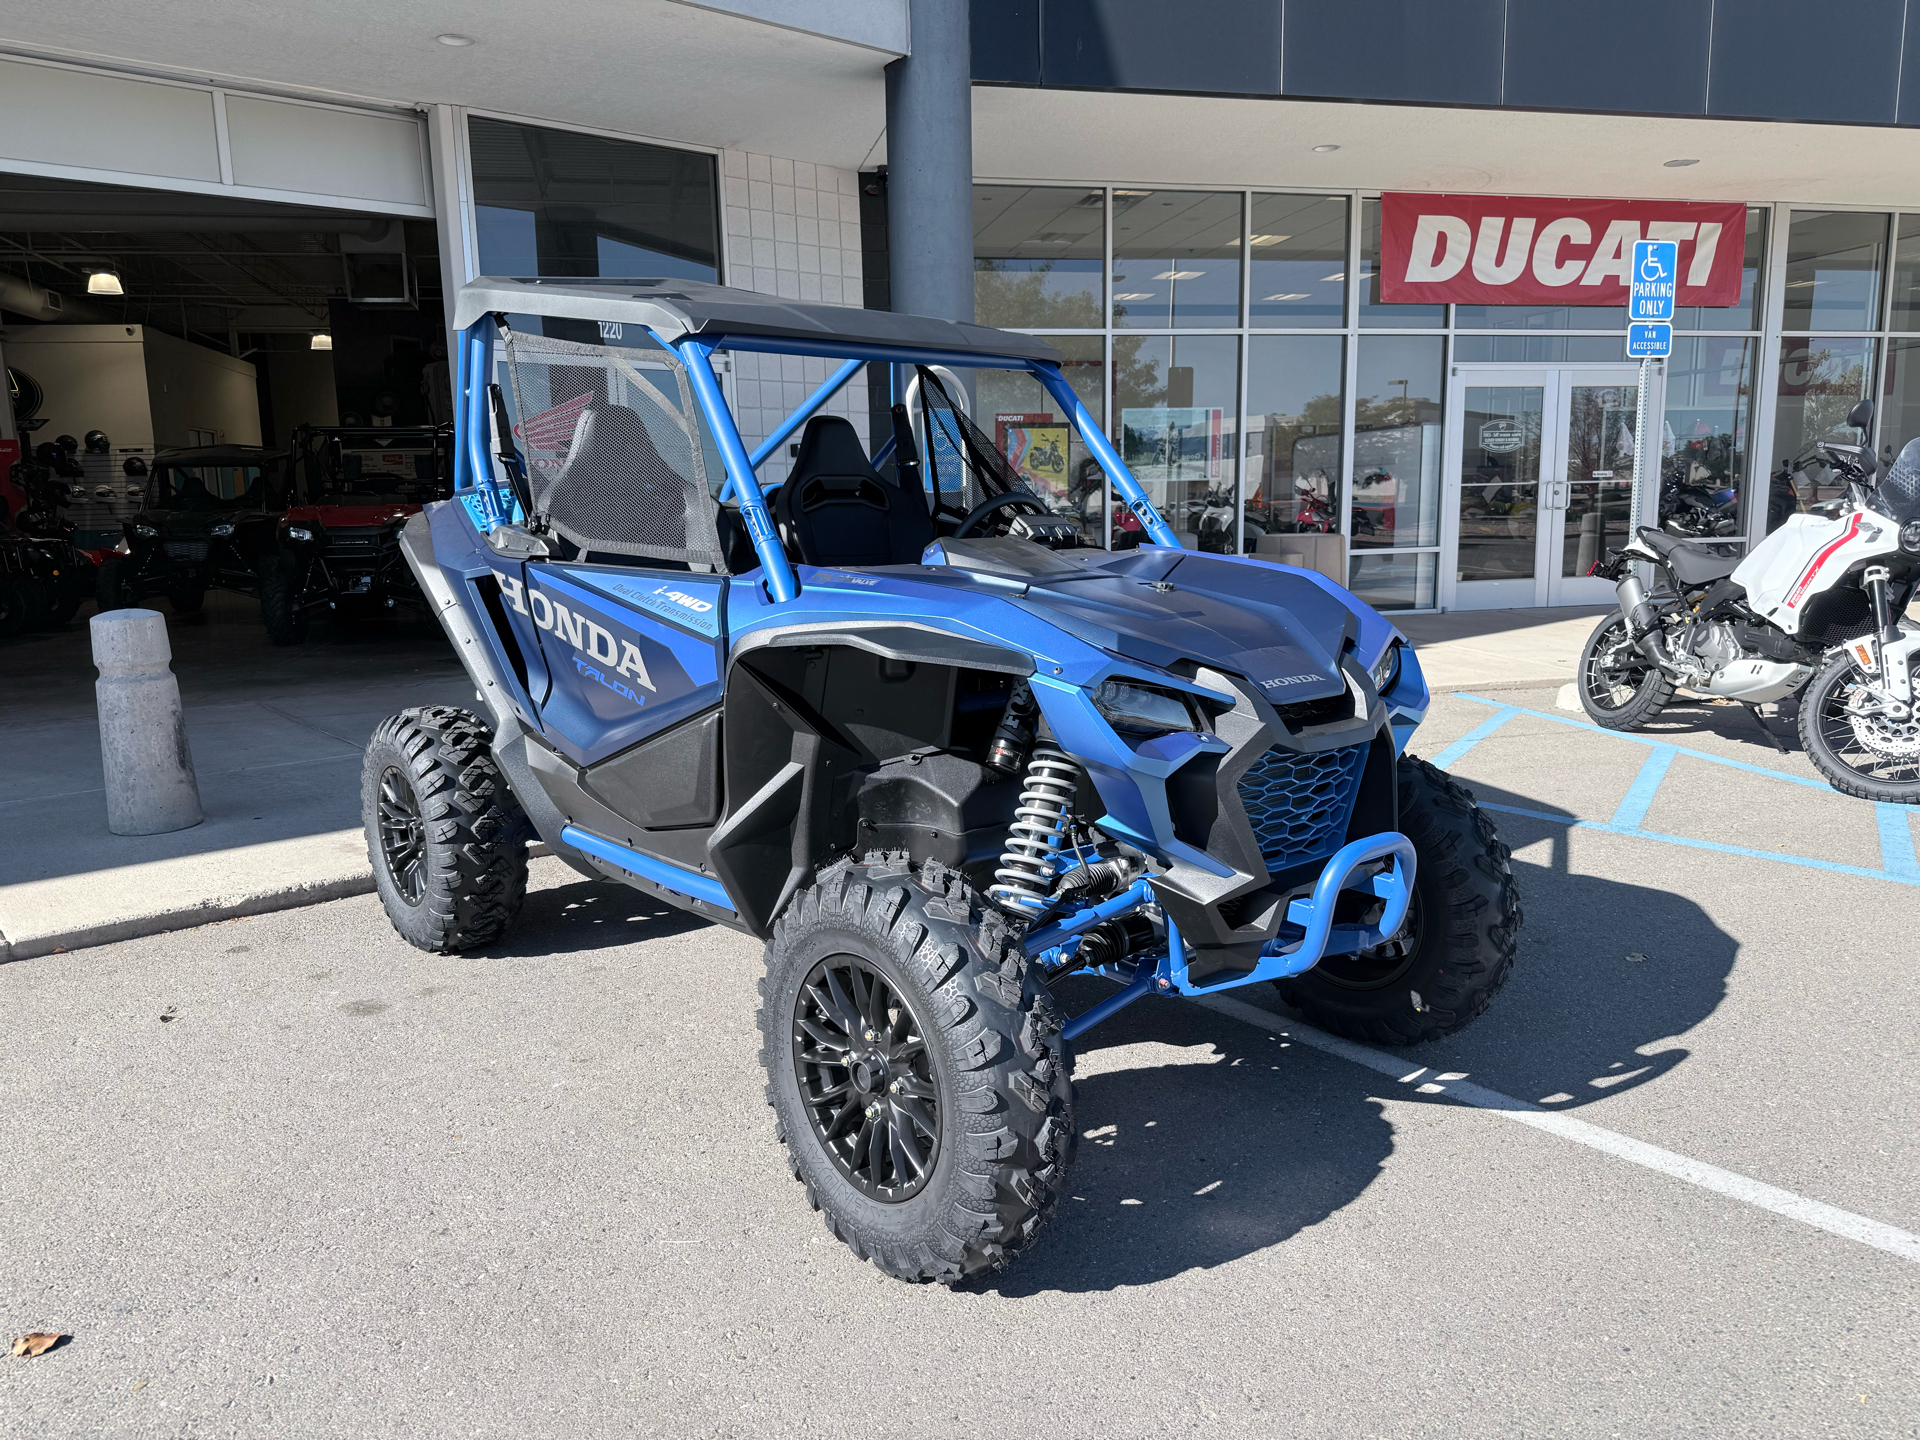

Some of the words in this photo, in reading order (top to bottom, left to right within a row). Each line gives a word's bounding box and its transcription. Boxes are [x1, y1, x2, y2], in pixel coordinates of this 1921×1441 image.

[1404, 214, 1723, 287] DUCATI
[1633, 282, 1673, 298] PARKING
[1639, 300, 1665, 315] ONLY
[597, 321, 623, 340] 1220
[1644, 331, 1657, 339] VAN
[1632, 342, 1667, 350] ACCESSIBLE
[612, 583, 633, 596] Dual
[630, 590, 657, 607] Clutch
[656, 600, 714, 631] Transmission
[652, 585, 713, 613] i-4WD
[491, 568, 657, 693] HONDA
[572, 656, 646, 707] TALON
[1259, 674, 1327, 689] HONDA
[1001, 679, 1035, 730] FOX
[806, 1142, 888, 1230] KENDA
